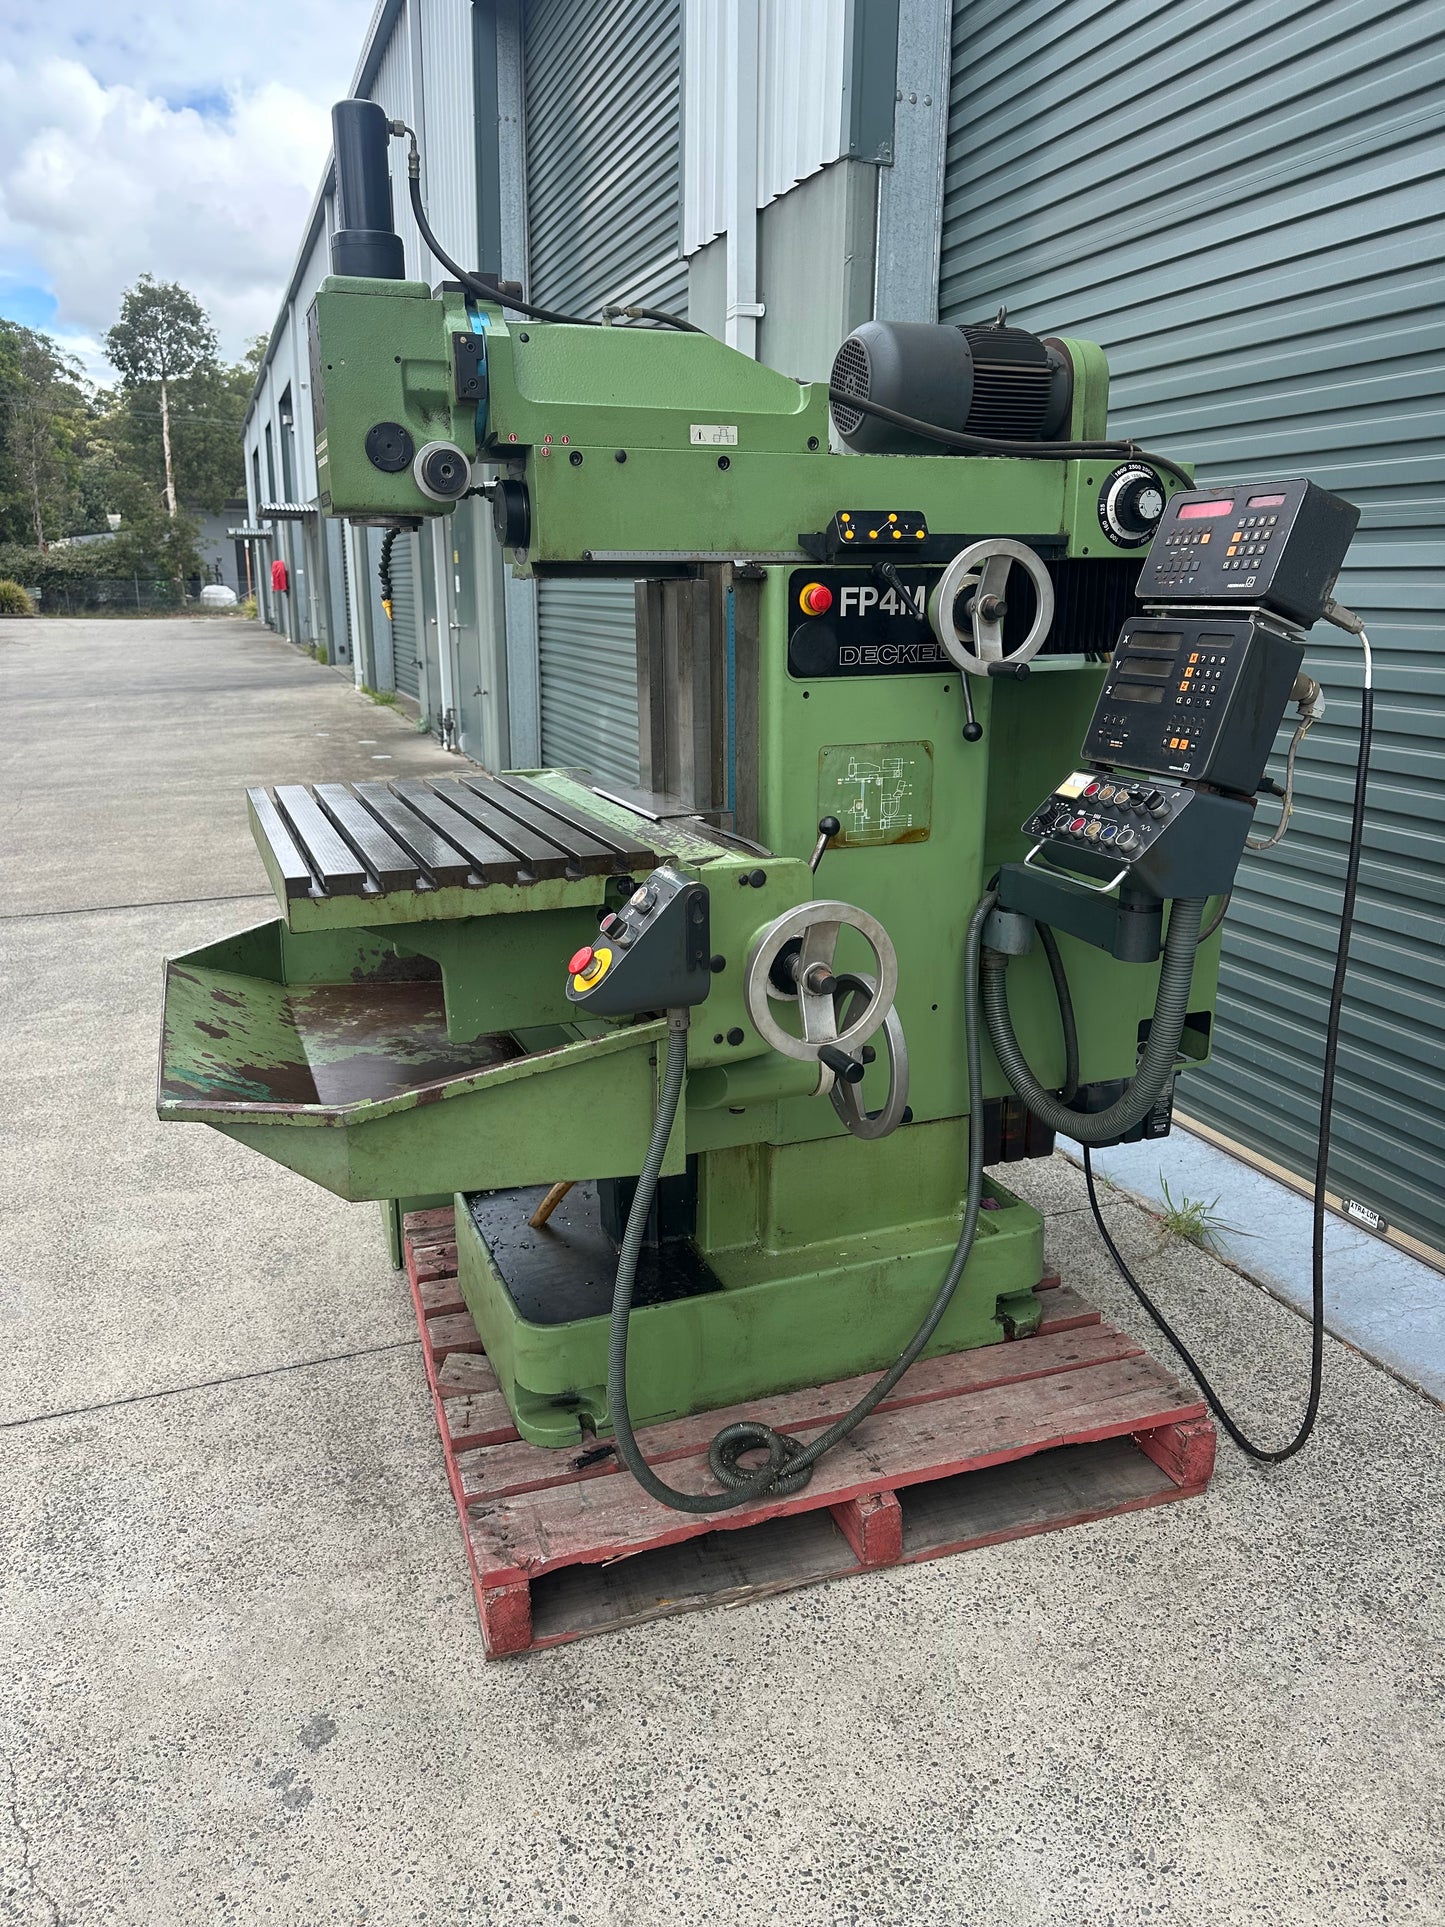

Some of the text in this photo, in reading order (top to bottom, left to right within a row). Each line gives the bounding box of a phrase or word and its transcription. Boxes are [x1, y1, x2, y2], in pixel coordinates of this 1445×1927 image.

[840, 585, 926, 617] FP4M
[1122, 634, 1130, 644] X
[839, 643, 951, 666] DECKEL
[1115, 660, 1122, 669] Y
[1105, 685, 1113, 694] Z
[1350, 1202, 1378, 1222] XTRA-LOK
